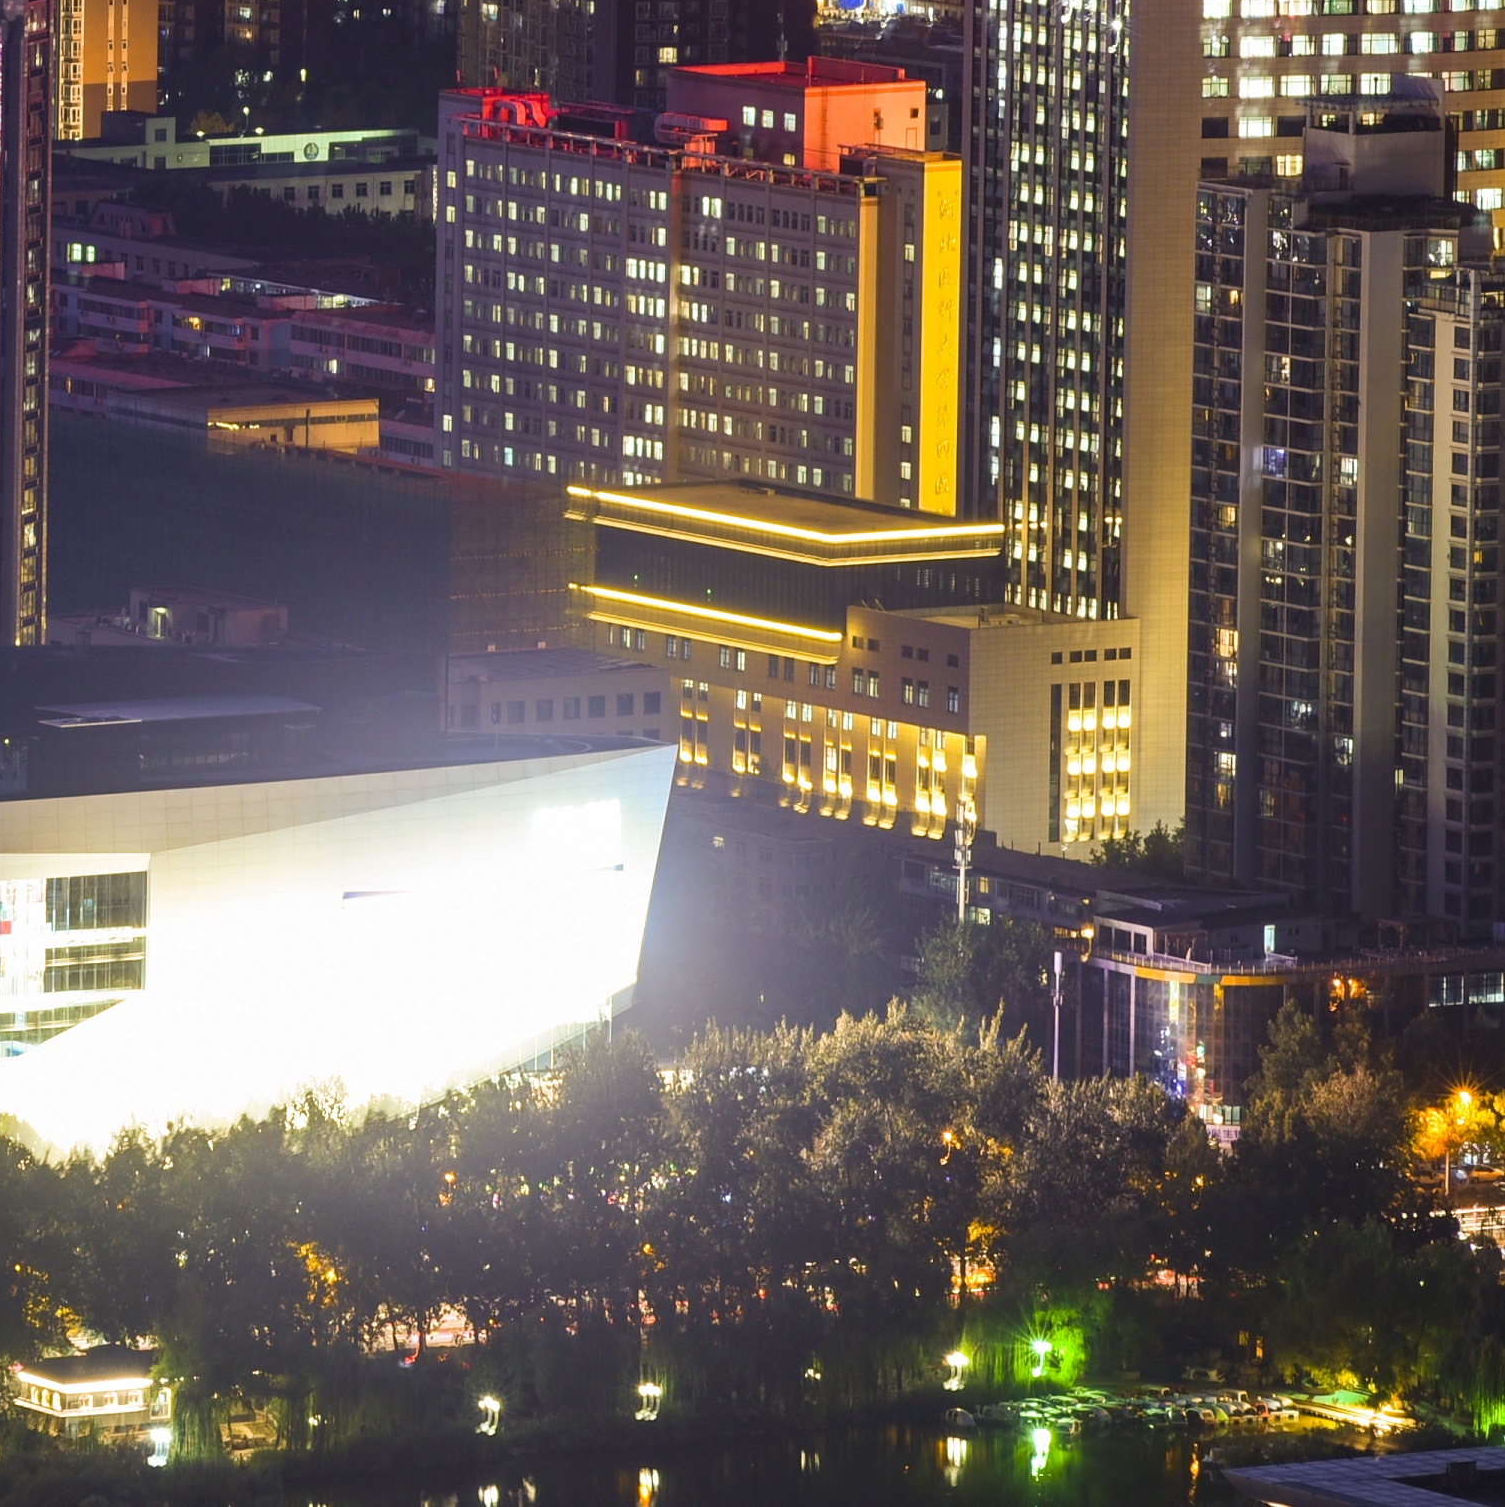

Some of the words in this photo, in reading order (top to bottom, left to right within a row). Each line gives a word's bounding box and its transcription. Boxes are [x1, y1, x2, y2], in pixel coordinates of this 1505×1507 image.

[934, 198, 957, 516] 河北医科大学第四医
